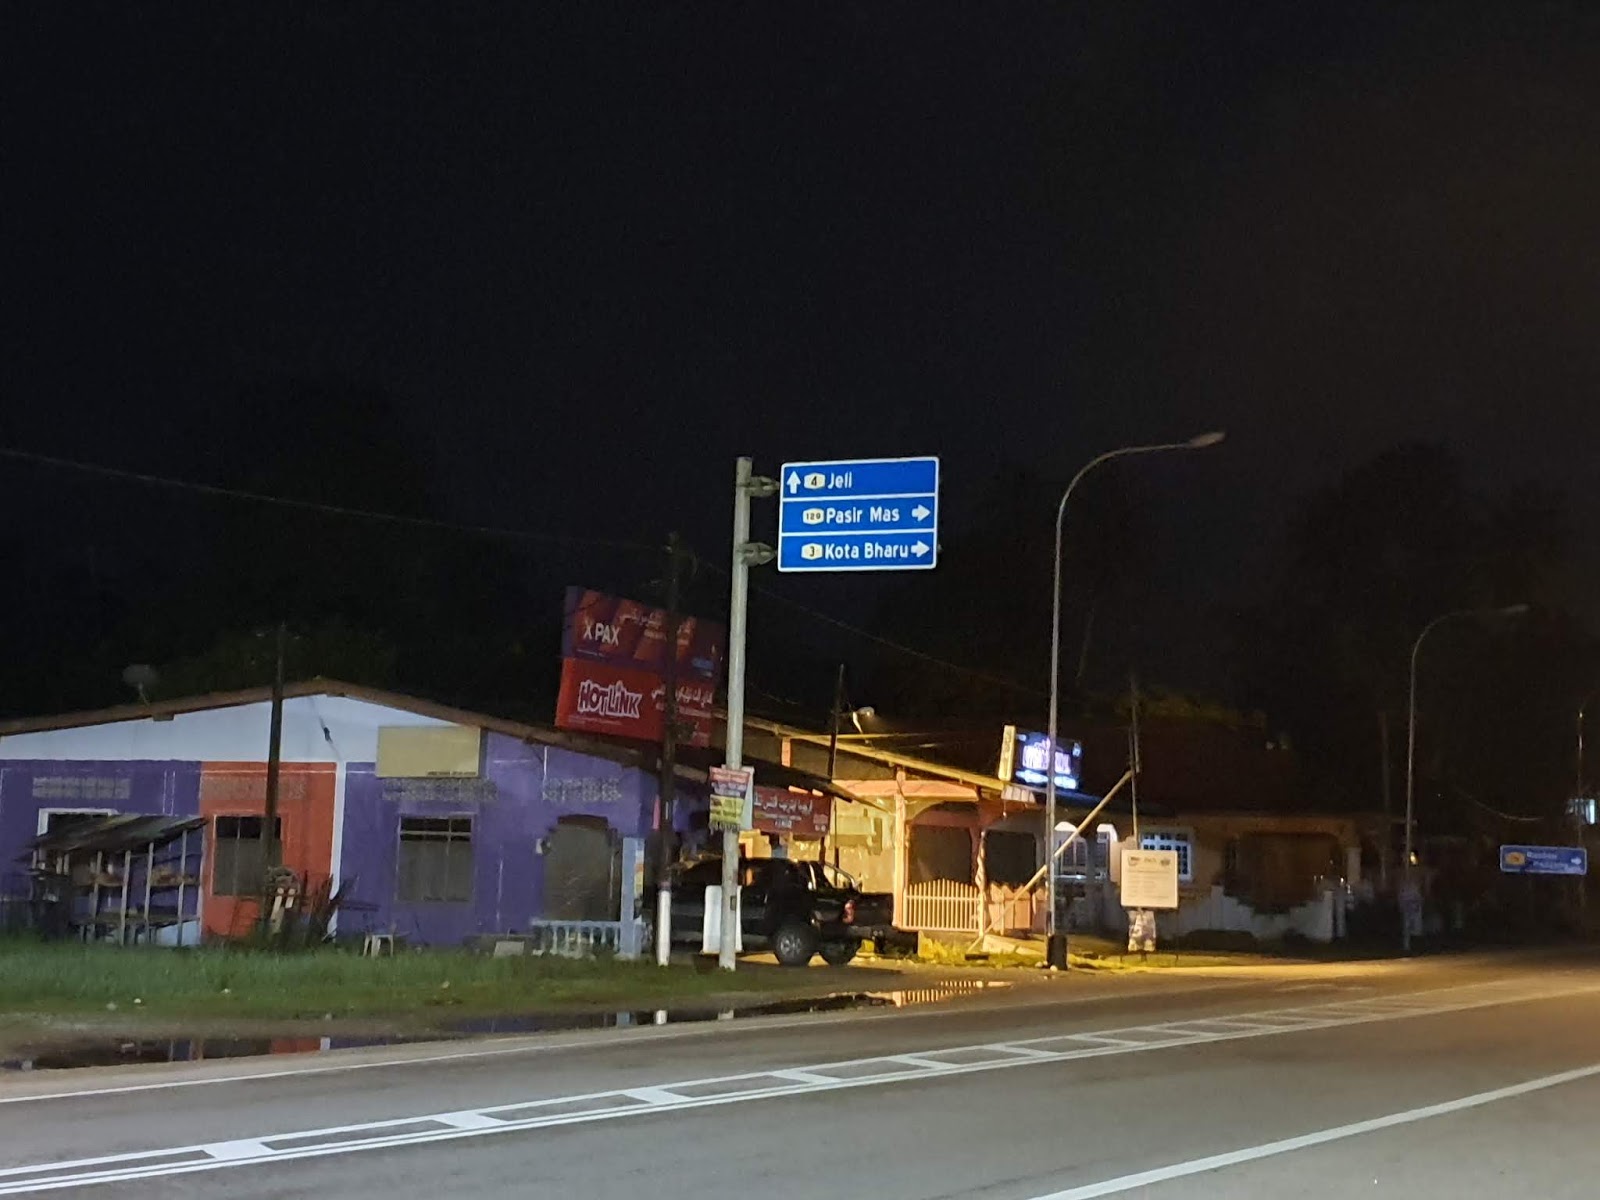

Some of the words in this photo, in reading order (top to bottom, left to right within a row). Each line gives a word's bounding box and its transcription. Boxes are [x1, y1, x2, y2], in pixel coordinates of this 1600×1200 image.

[828, 471, 852, 489] Jeli
[826, 507, 863, 524] Pasir
[870, 506, 900, 522] Mas
[825, 543, 860, 560] Kota
[864, 542, 908, 559] Bharu
